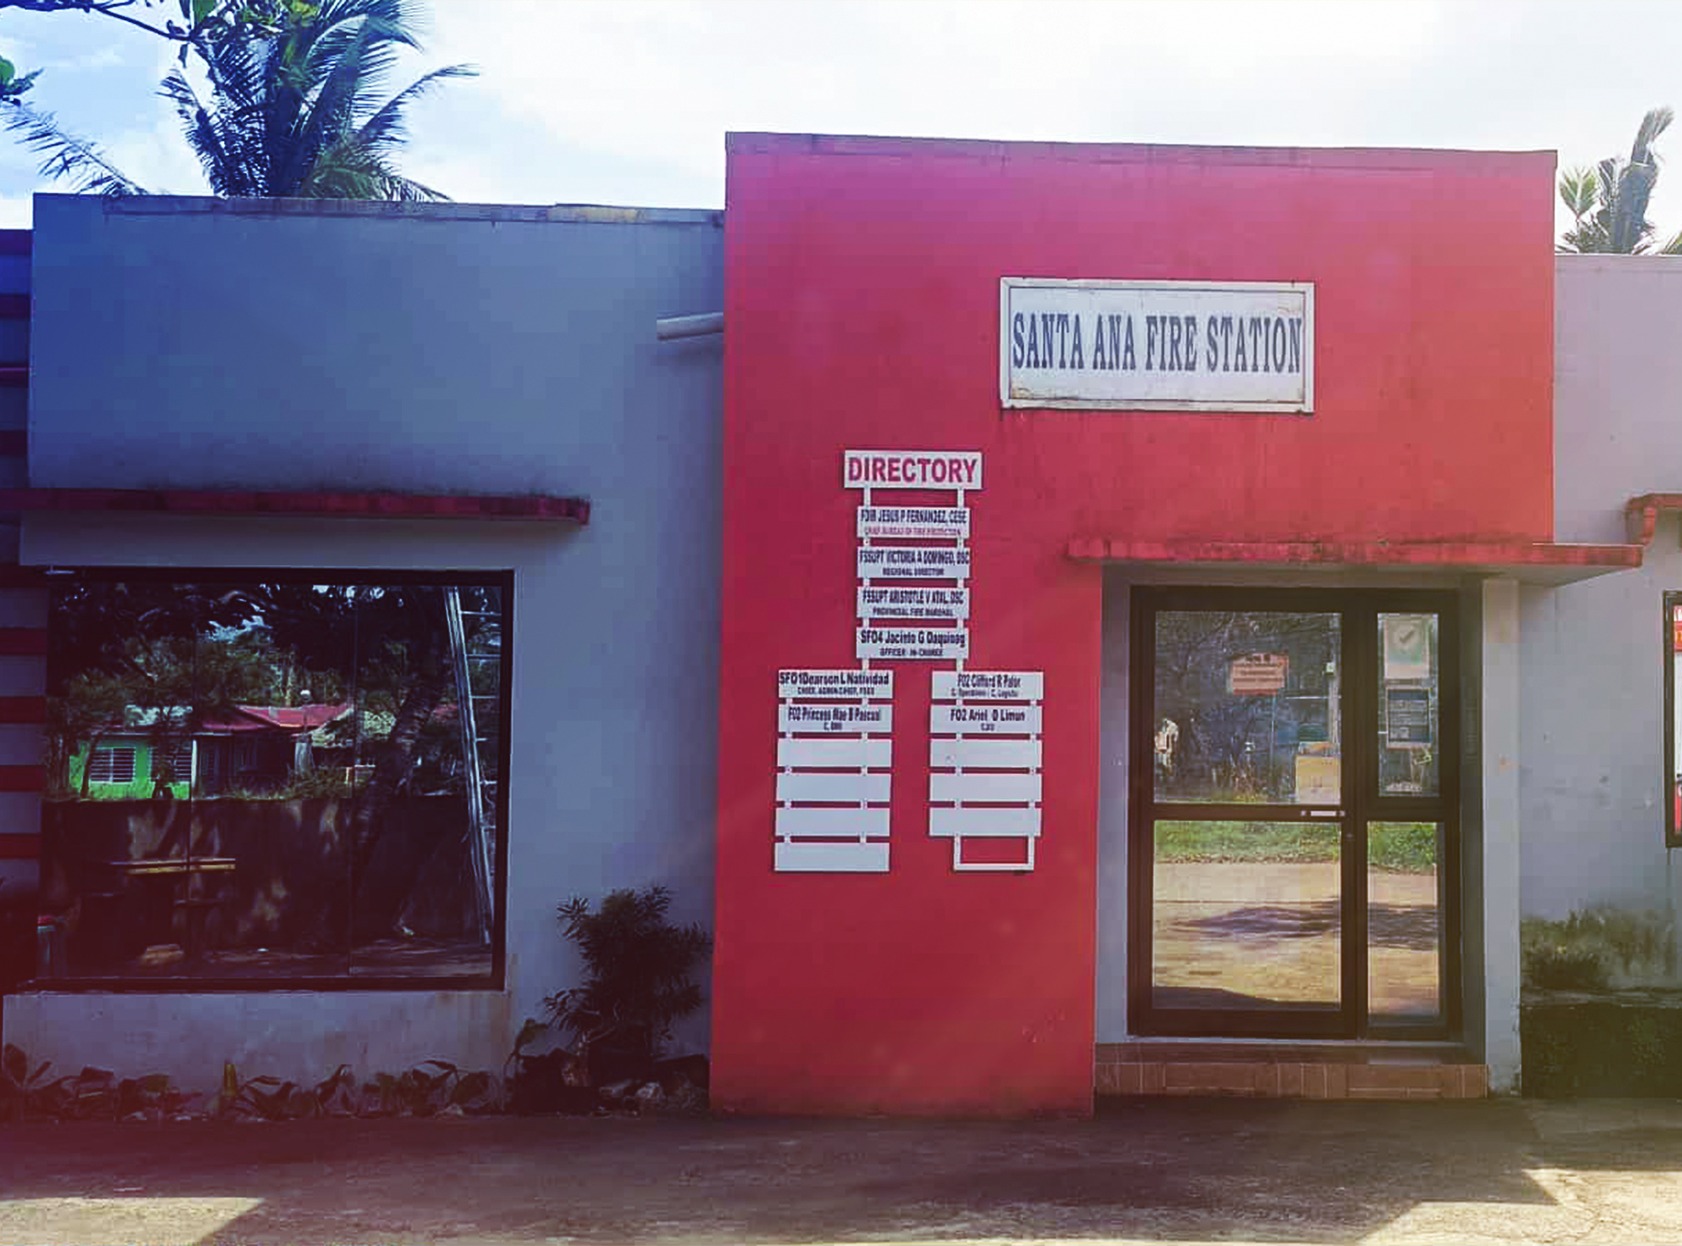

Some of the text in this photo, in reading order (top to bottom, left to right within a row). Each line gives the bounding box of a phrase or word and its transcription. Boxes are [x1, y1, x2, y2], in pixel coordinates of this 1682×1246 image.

[1013, 313, 1302, 373] SANTA ANA FIRE STATION
[848, 457, 977, 483] DIRECTORY
